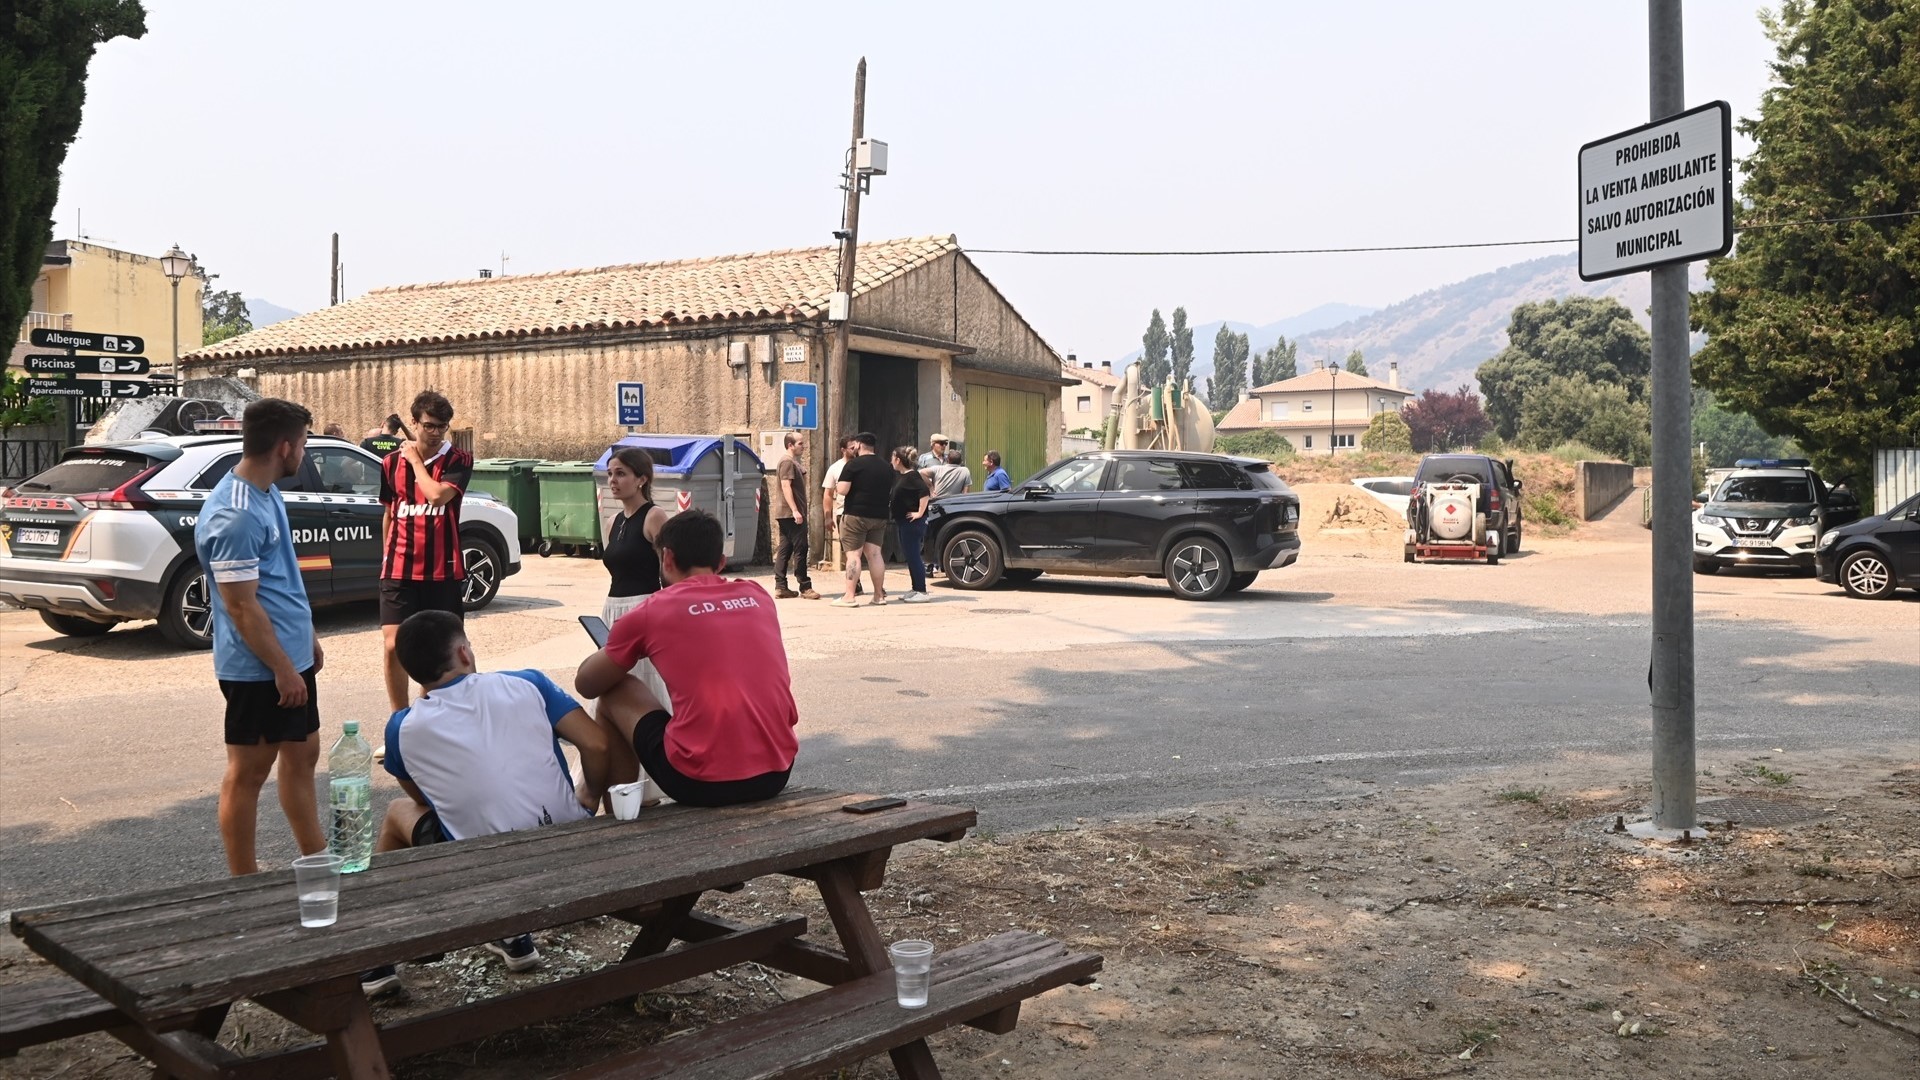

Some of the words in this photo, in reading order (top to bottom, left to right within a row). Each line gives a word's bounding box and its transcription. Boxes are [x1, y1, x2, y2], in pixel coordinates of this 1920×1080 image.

[1615, 131, 1681, 166] PROHIBIDA
[1586, 187, 1599, 205] LA
[1602, 176, 1638, 201] VENTA
[1641, 153, 1717, 191] AMBULANTE
[1587, 211, 1622, 235] SALVO
[1624, 186, 1715, 226] AUTORIZACIÓN
[1616, 229, 1683, 259] MUNICIPAL
[46, 333, 92, 348] Albergue
[31, 358, 76, 369] Piscinas
[29, 379, 58, 387] Parque
[29, 387, 84, 396] Aparcamiento
[292, 528, 330, 544] RDIA
[334, 525, 373, 542] CIVIL
[688, 602, 720, 616] C.D.
[721, 596, 760, 611] BREA
